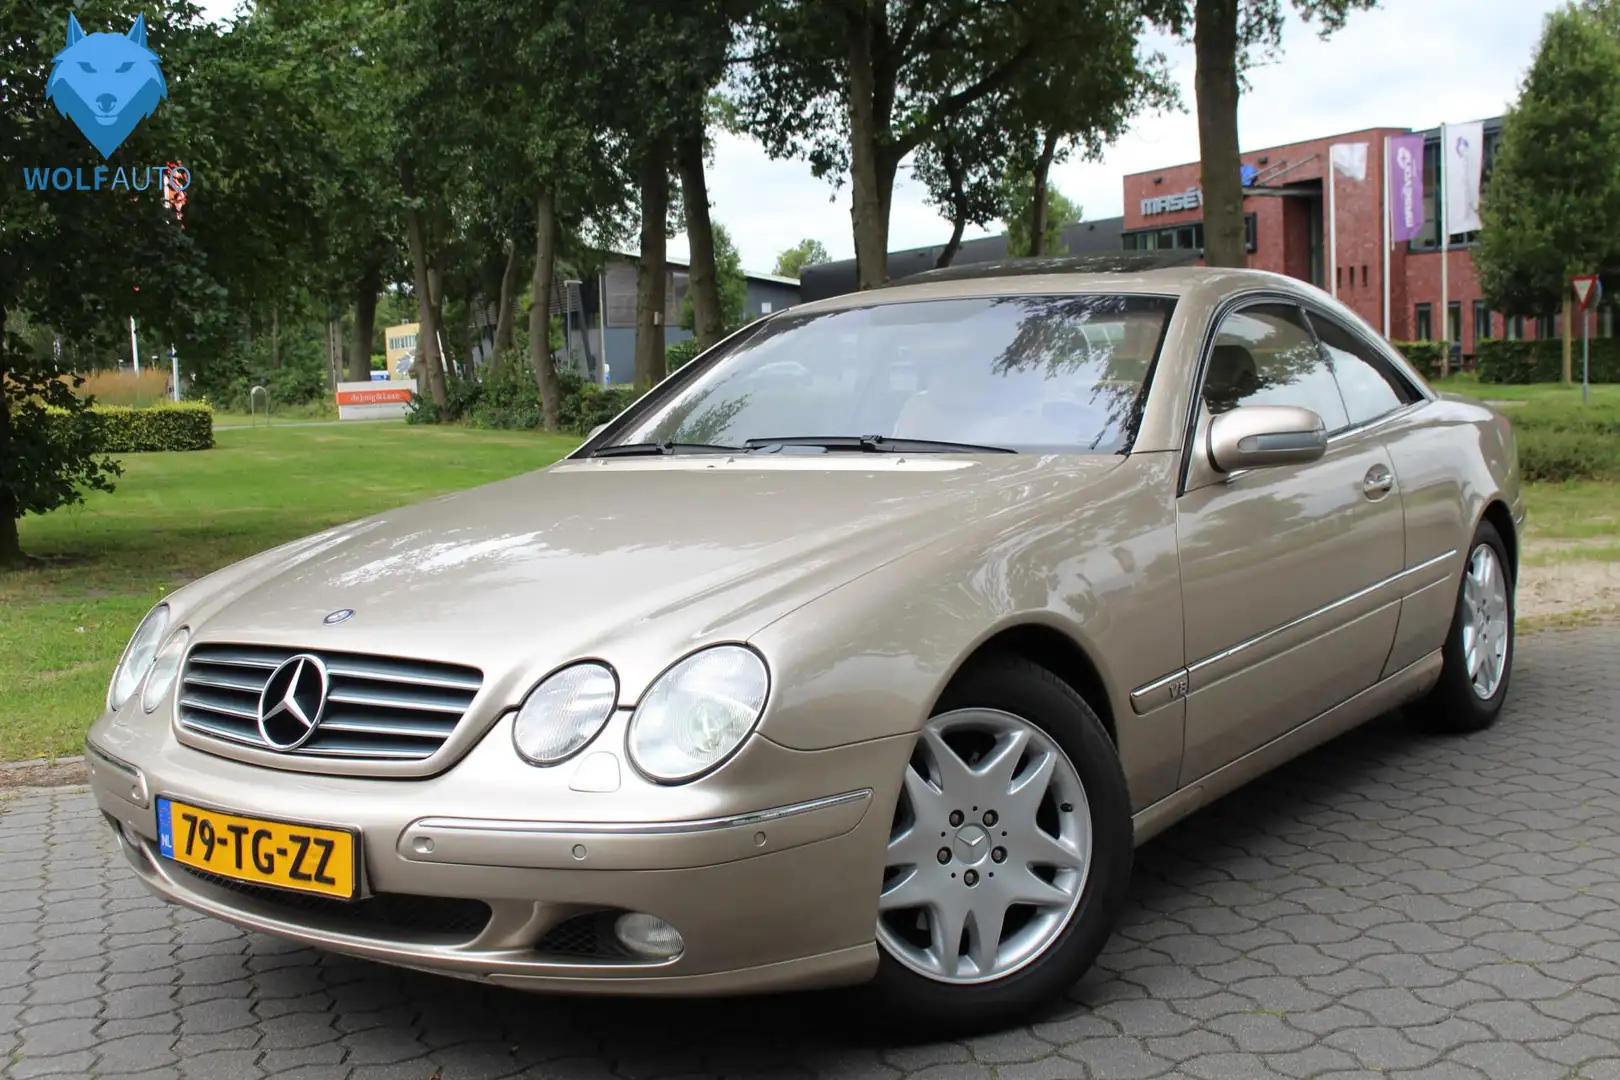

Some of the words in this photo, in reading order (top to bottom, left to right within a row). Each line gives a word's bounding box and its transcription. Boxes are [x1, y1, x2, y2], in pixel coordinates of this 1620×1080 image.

[1140, 187, 1203, 216] MASÉ
[1168, 681, 1188, 698] V8
[160, 832, 173, 849] NL
[182, 812, 336, 886] 79-TG-ZZ
